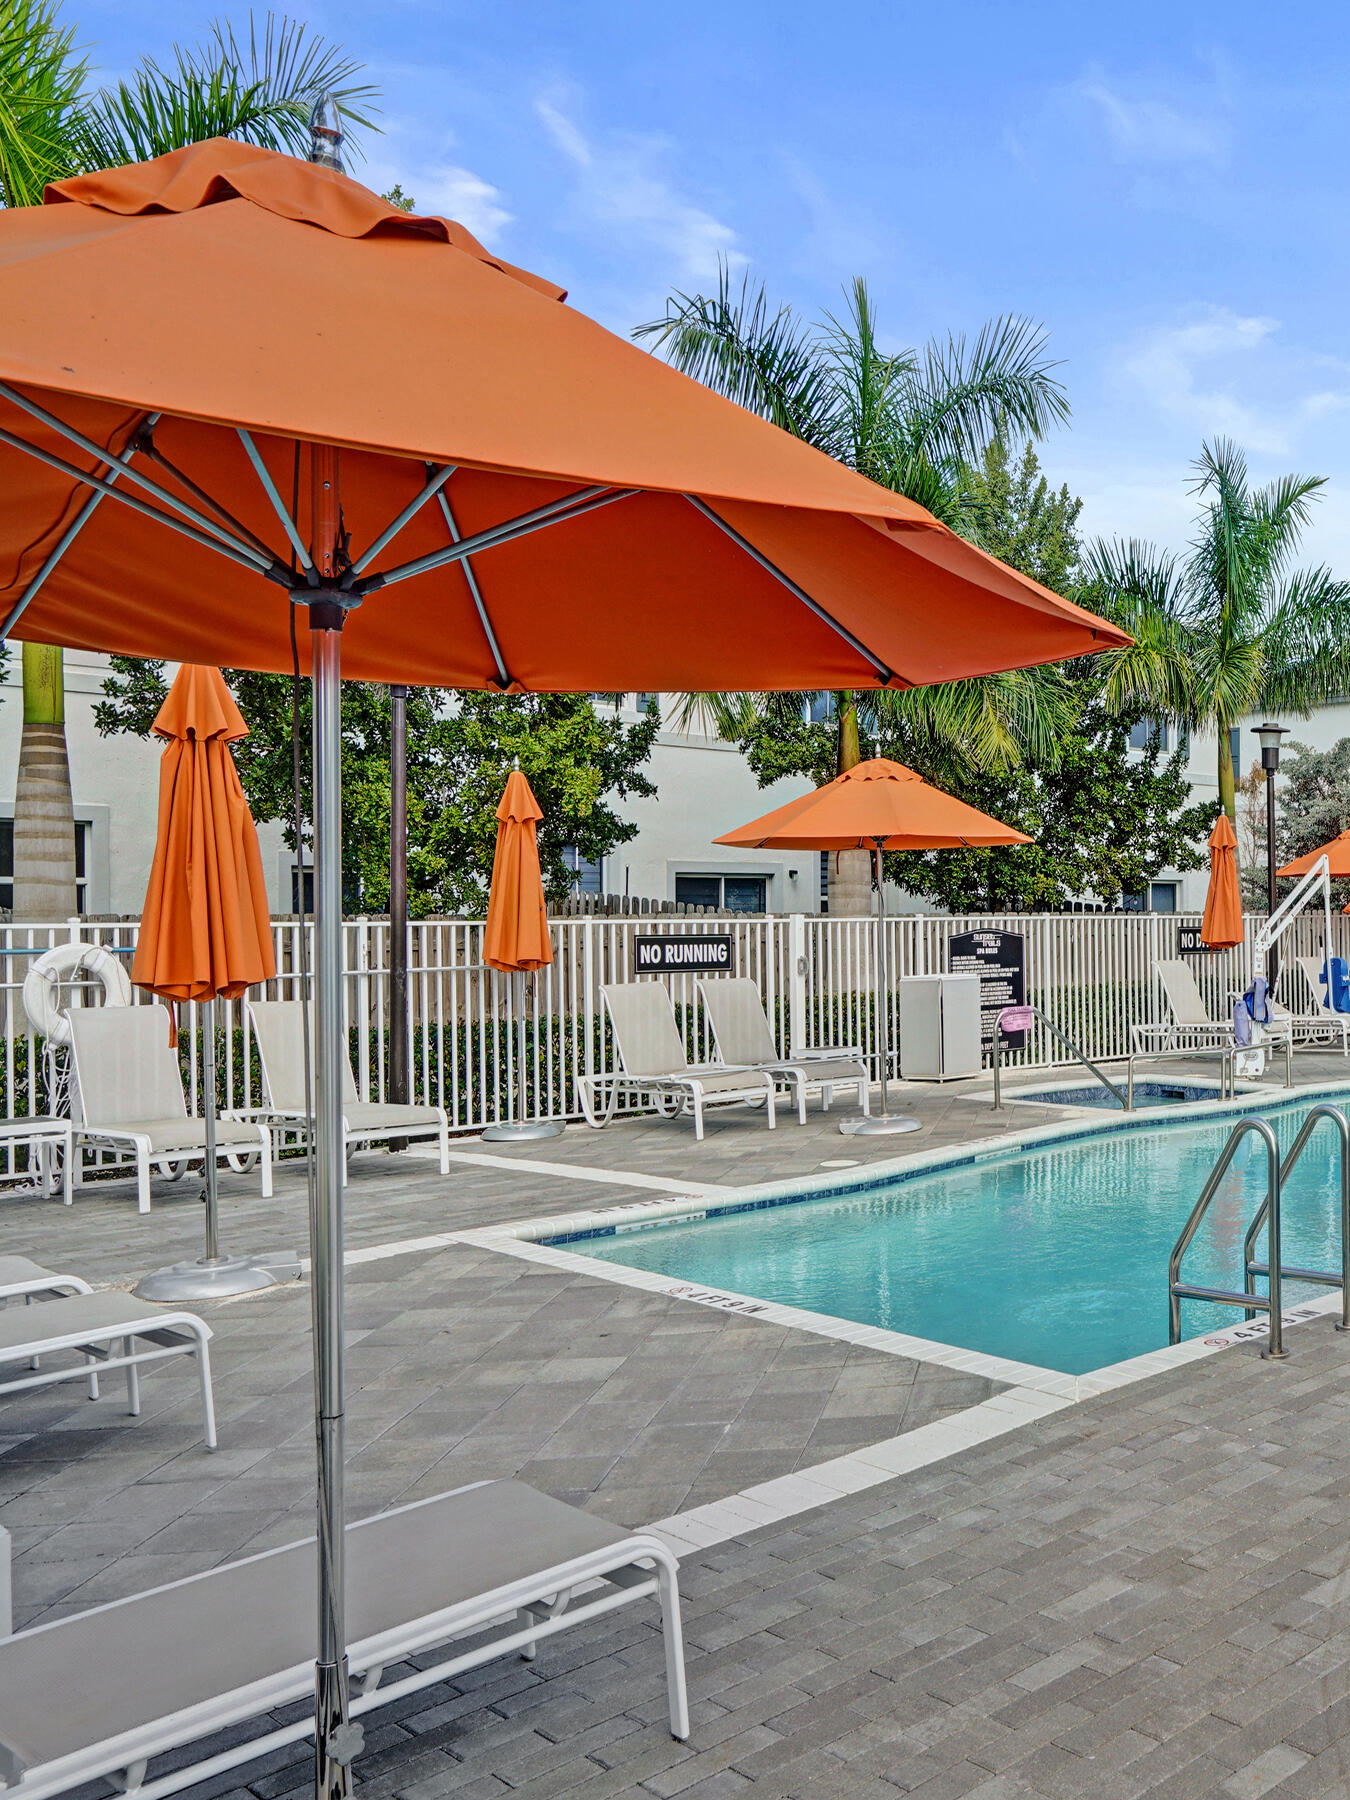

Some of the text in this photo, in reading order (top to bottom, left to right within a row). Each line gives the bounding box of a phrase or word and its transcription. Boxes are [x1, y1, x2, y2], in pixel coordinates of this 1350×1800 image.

[1181, 933, 1194, 948] NO
[640, 944, 728, 964] NO RUNNING
[697, 1294, 732, 1304] FT
[736, 1304, 769, 1314] IN
[1290, 1309, 1321, 1318] IN
